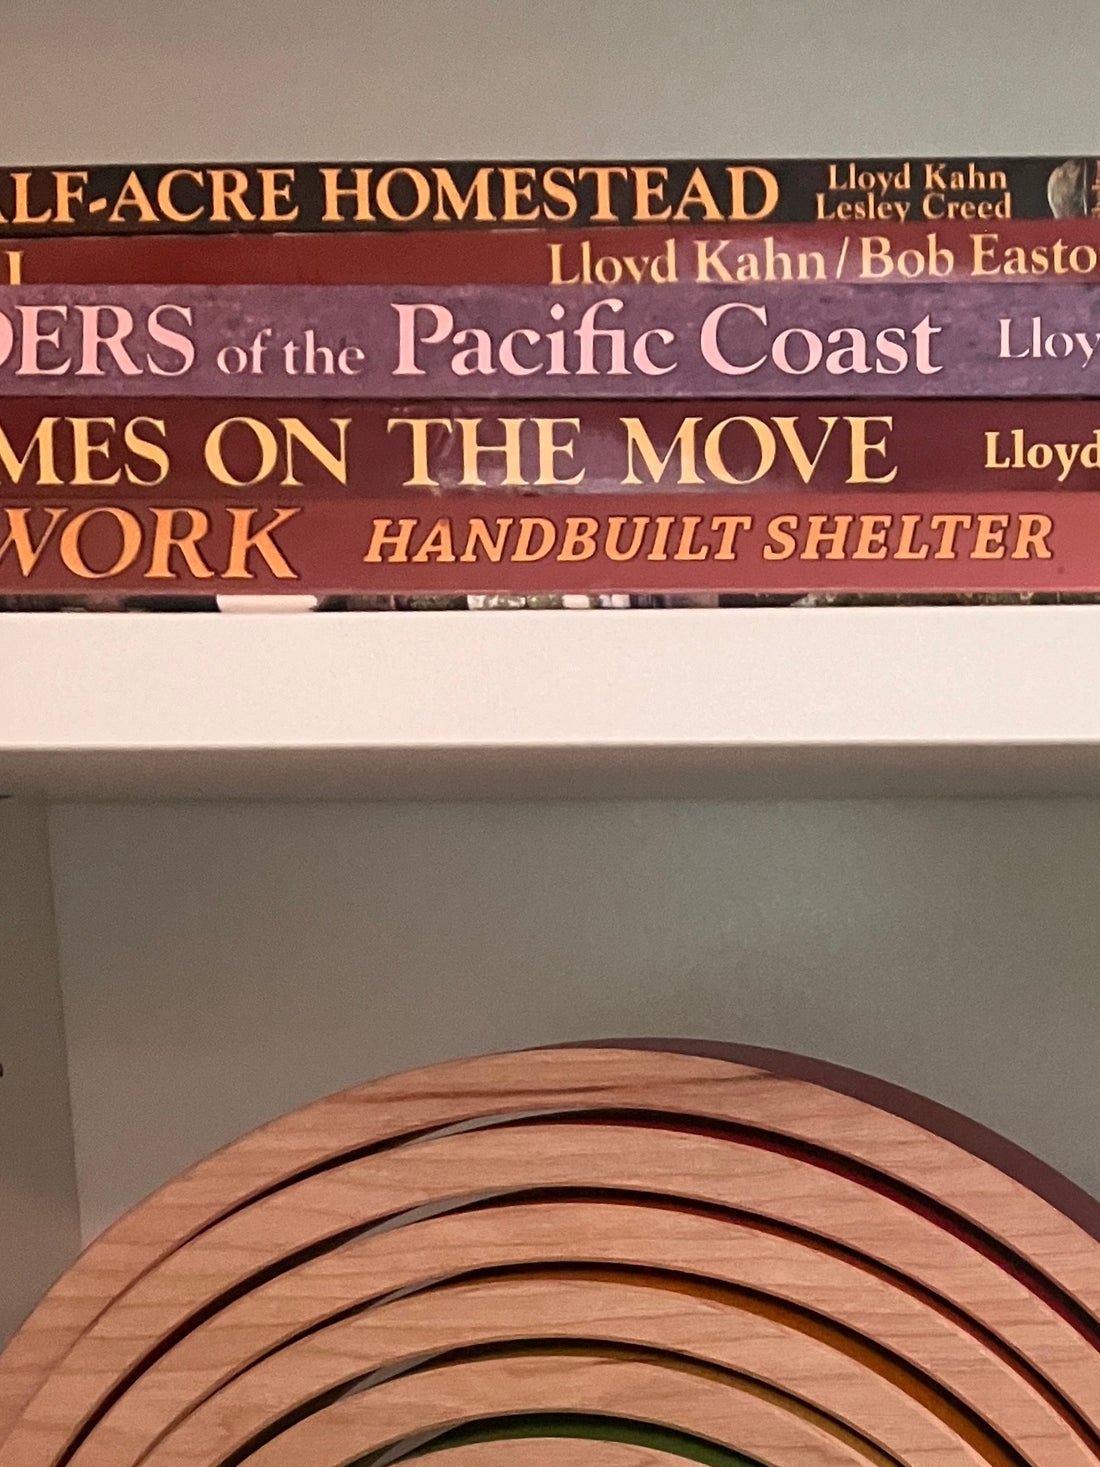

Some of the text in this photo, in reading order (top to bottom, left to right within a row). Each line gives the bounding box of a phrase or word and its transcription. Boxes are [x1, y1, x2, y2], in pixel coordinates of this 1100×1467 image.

[0, 166, 781, 225] LF-ACRE HOMESTEAD
[827, 162, 1008, 196] Lloyd Kahn
[815, 191, 1013, 223] Lesley Creed
[547, 237, 678, 284] Lloyd
[0, 298, 943, 376] ERS of the Pacific Coast
[204, 416, 353, 487] ON
[387, 416, 586, 487] THE
[619, 415, 899, 486] MOVE
[0, 506, 302, 580] WORK
[362, 513, 1054, 564] HANDBUILT SHELTER
